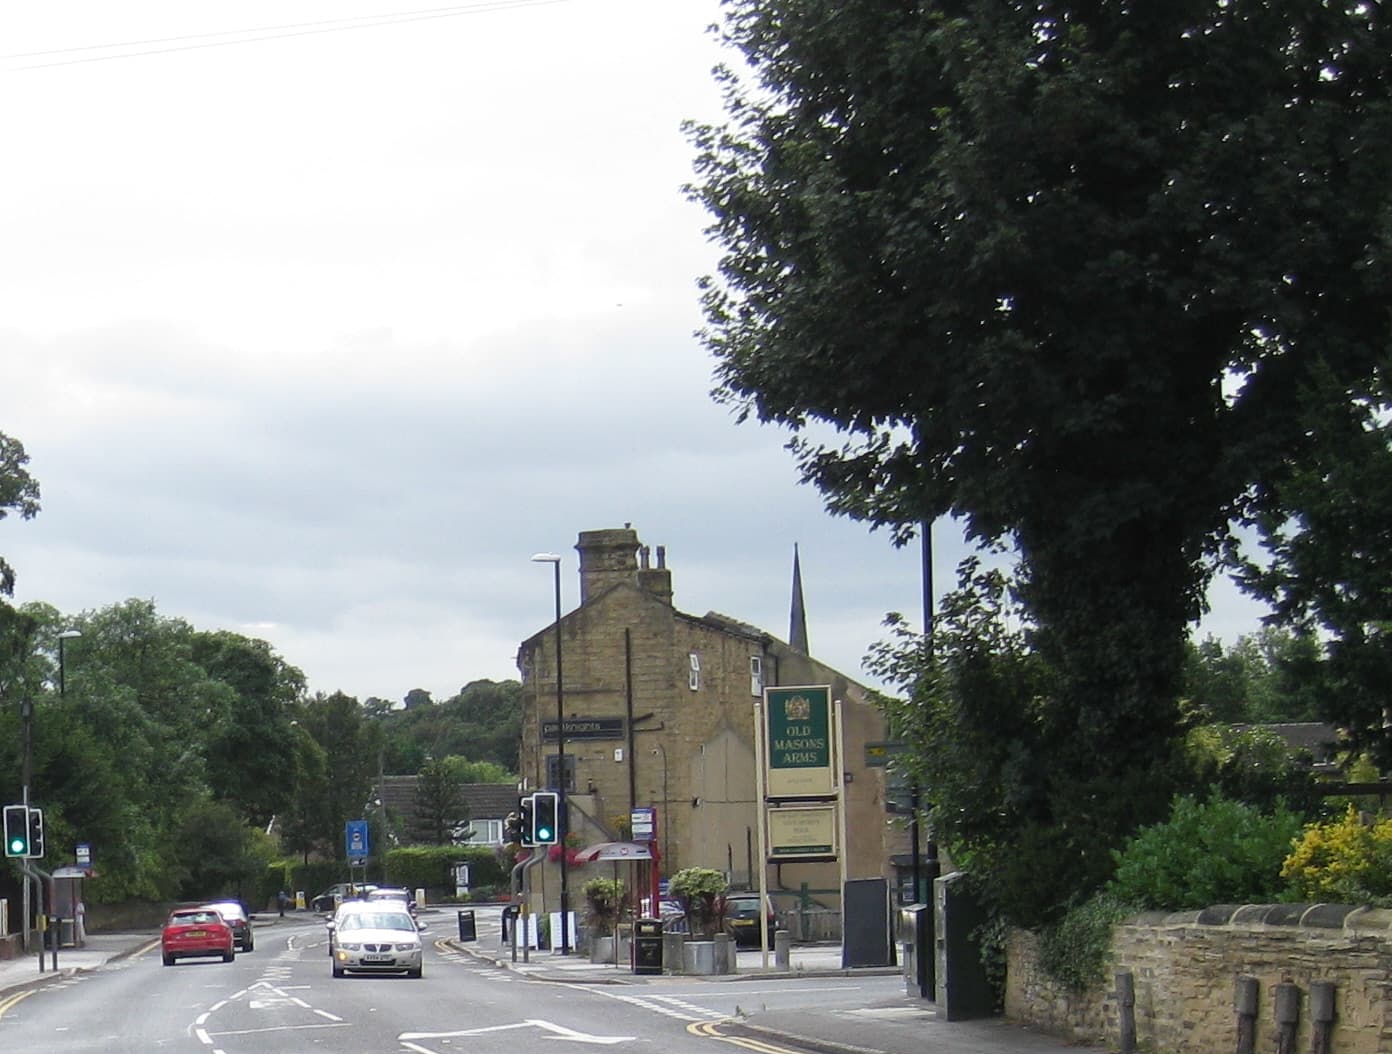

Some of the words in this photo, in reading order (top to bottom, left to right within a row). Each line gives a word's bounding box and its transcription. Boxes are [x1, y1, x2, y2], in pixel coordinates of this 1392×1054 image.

[786, 726, 811, 737] OLD
[774, 738, 824, 750] MASONS
[783, 752, 817, 763] ARMS
